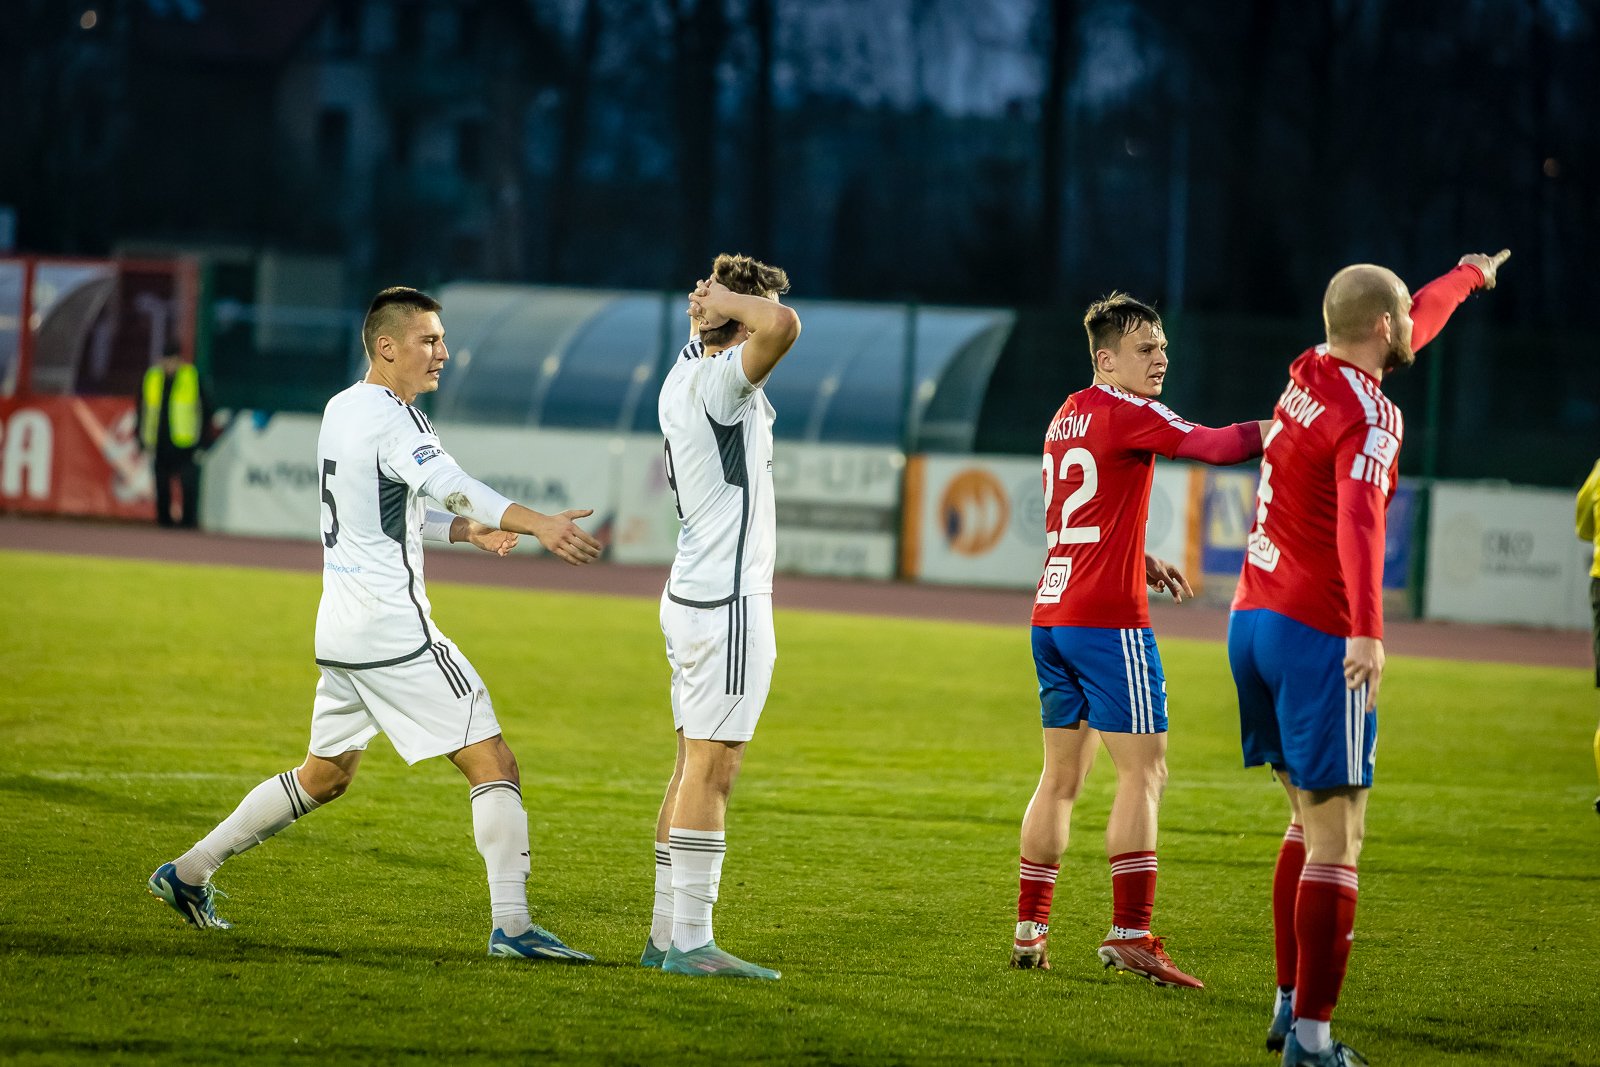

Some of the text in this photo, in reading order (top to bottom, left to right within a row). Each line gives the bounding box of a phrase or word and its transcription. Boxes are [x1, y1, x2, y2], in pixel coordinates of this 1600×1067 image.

[0, 406, 53, 499] A
[1042, 447, 1101, 549] 22
[322, 458, 340, 549] 5
